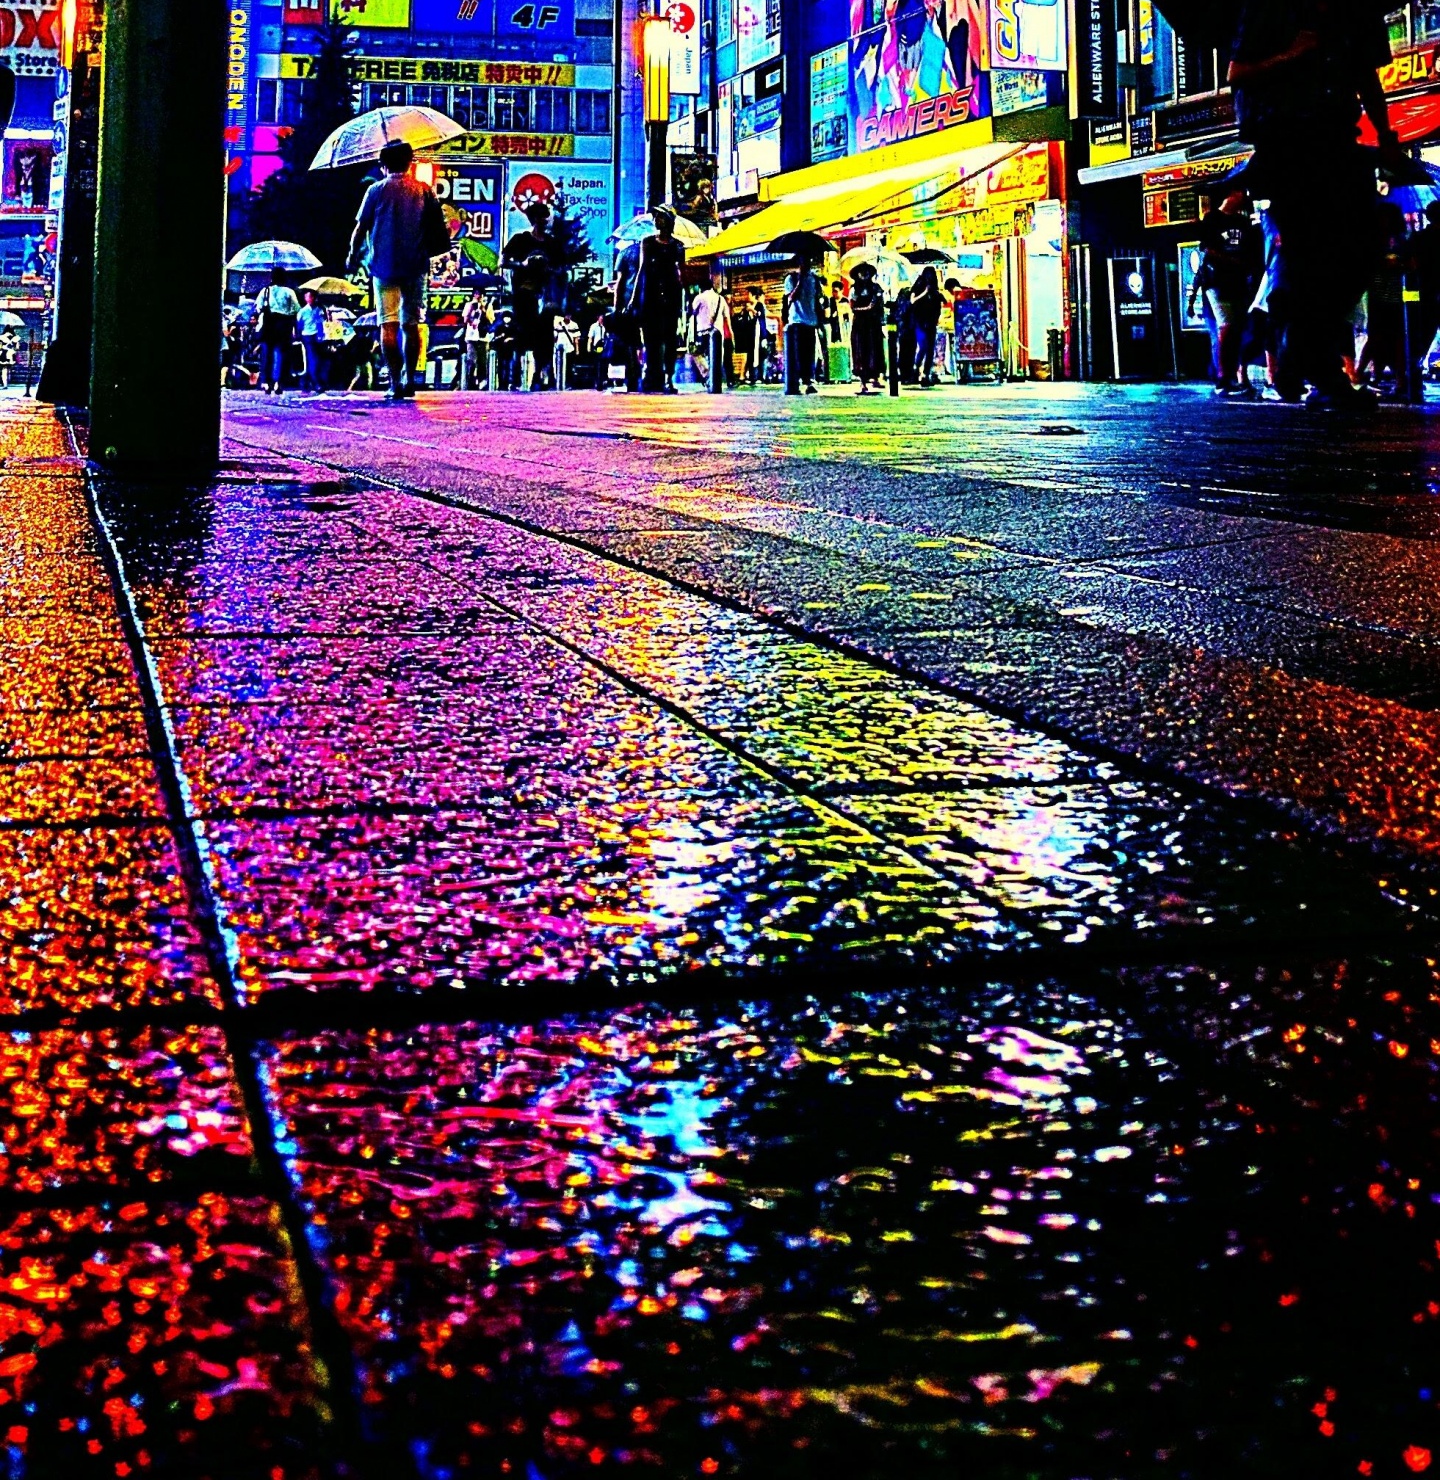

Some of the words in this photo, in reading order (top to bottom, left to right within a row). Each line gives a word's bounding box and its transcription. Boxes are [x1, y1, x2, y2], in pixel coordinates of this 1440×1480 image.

[510, 3, 561, 31] 4F
[228, 9, 248, 111] ONODEN
[1092, 22, 1103, 104] ALIENWARE
[858, 83, 975, 150] GAMERS
[568, 176, 608, 191] Japan.
[564, 193, 608, 206] Tax-free
[578, 206, 608, 220] Shop
[465, 211, 492, 239] 迎
